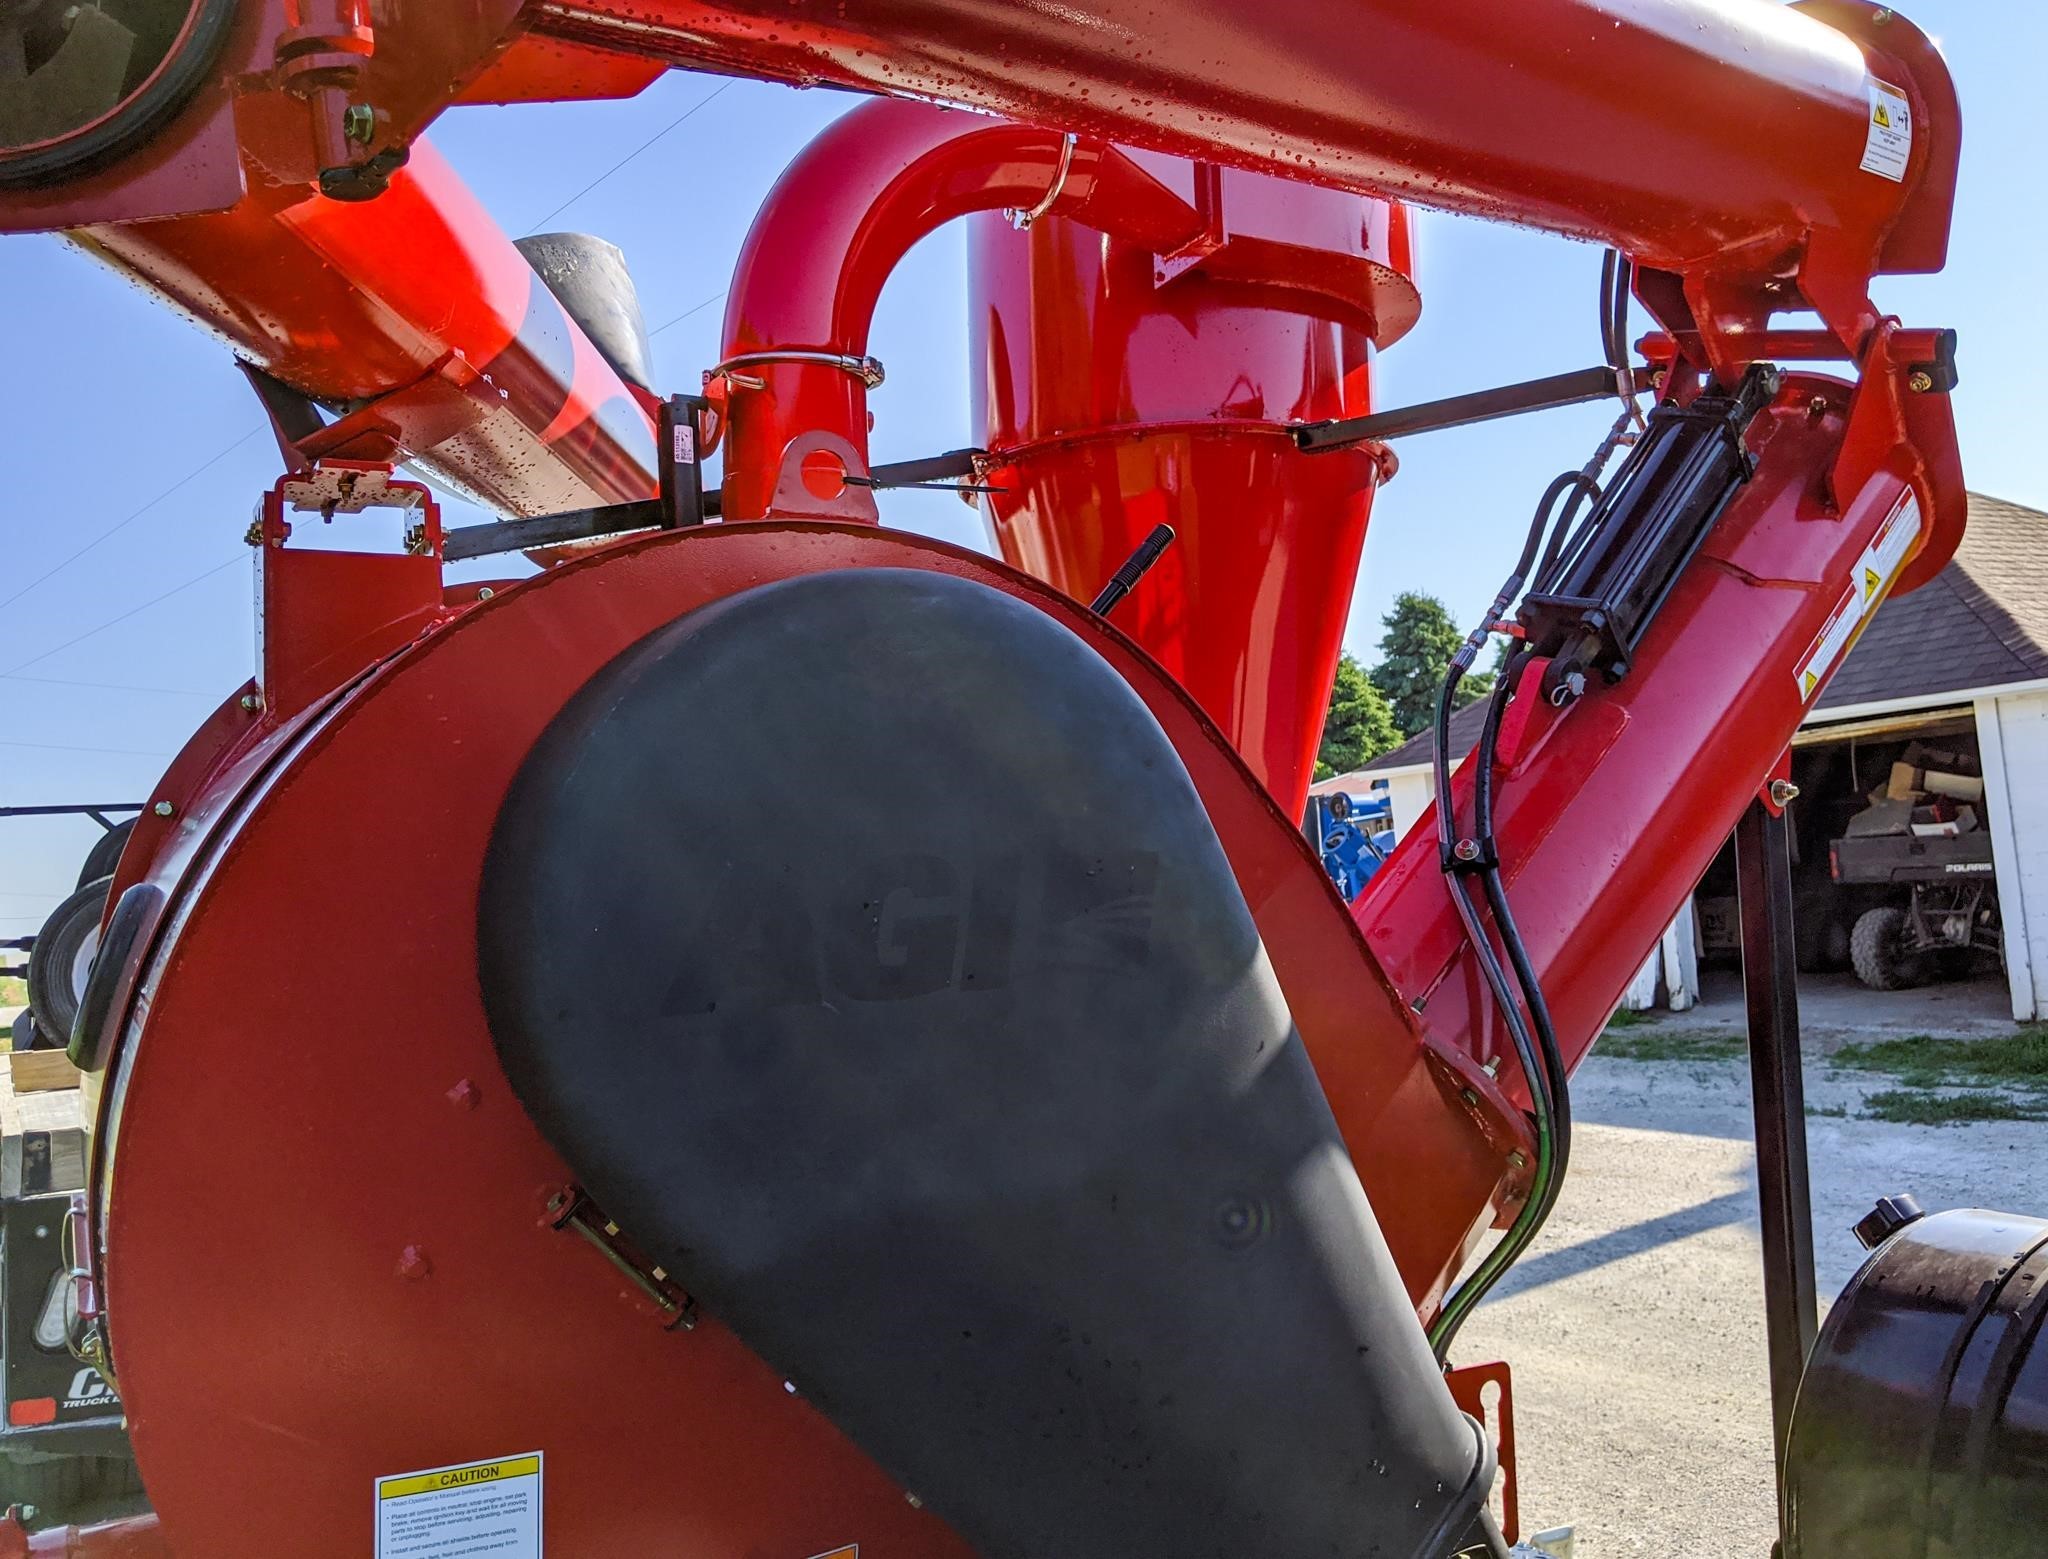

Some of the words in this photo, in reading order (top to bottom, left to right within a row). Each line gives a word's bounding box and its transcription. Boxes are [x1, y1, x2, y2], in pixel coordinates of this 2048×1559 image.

[1820, 615, 1837, 639] DANGER
[1945, 863, 1992, 873] POLARIS
[68, 1366, 115, 1399] C
[63, 1397, 109, 1408] TRUCK
[440, 1466, 500, 1486] CAUTION
[507, 1499, 528, 1507] moving
